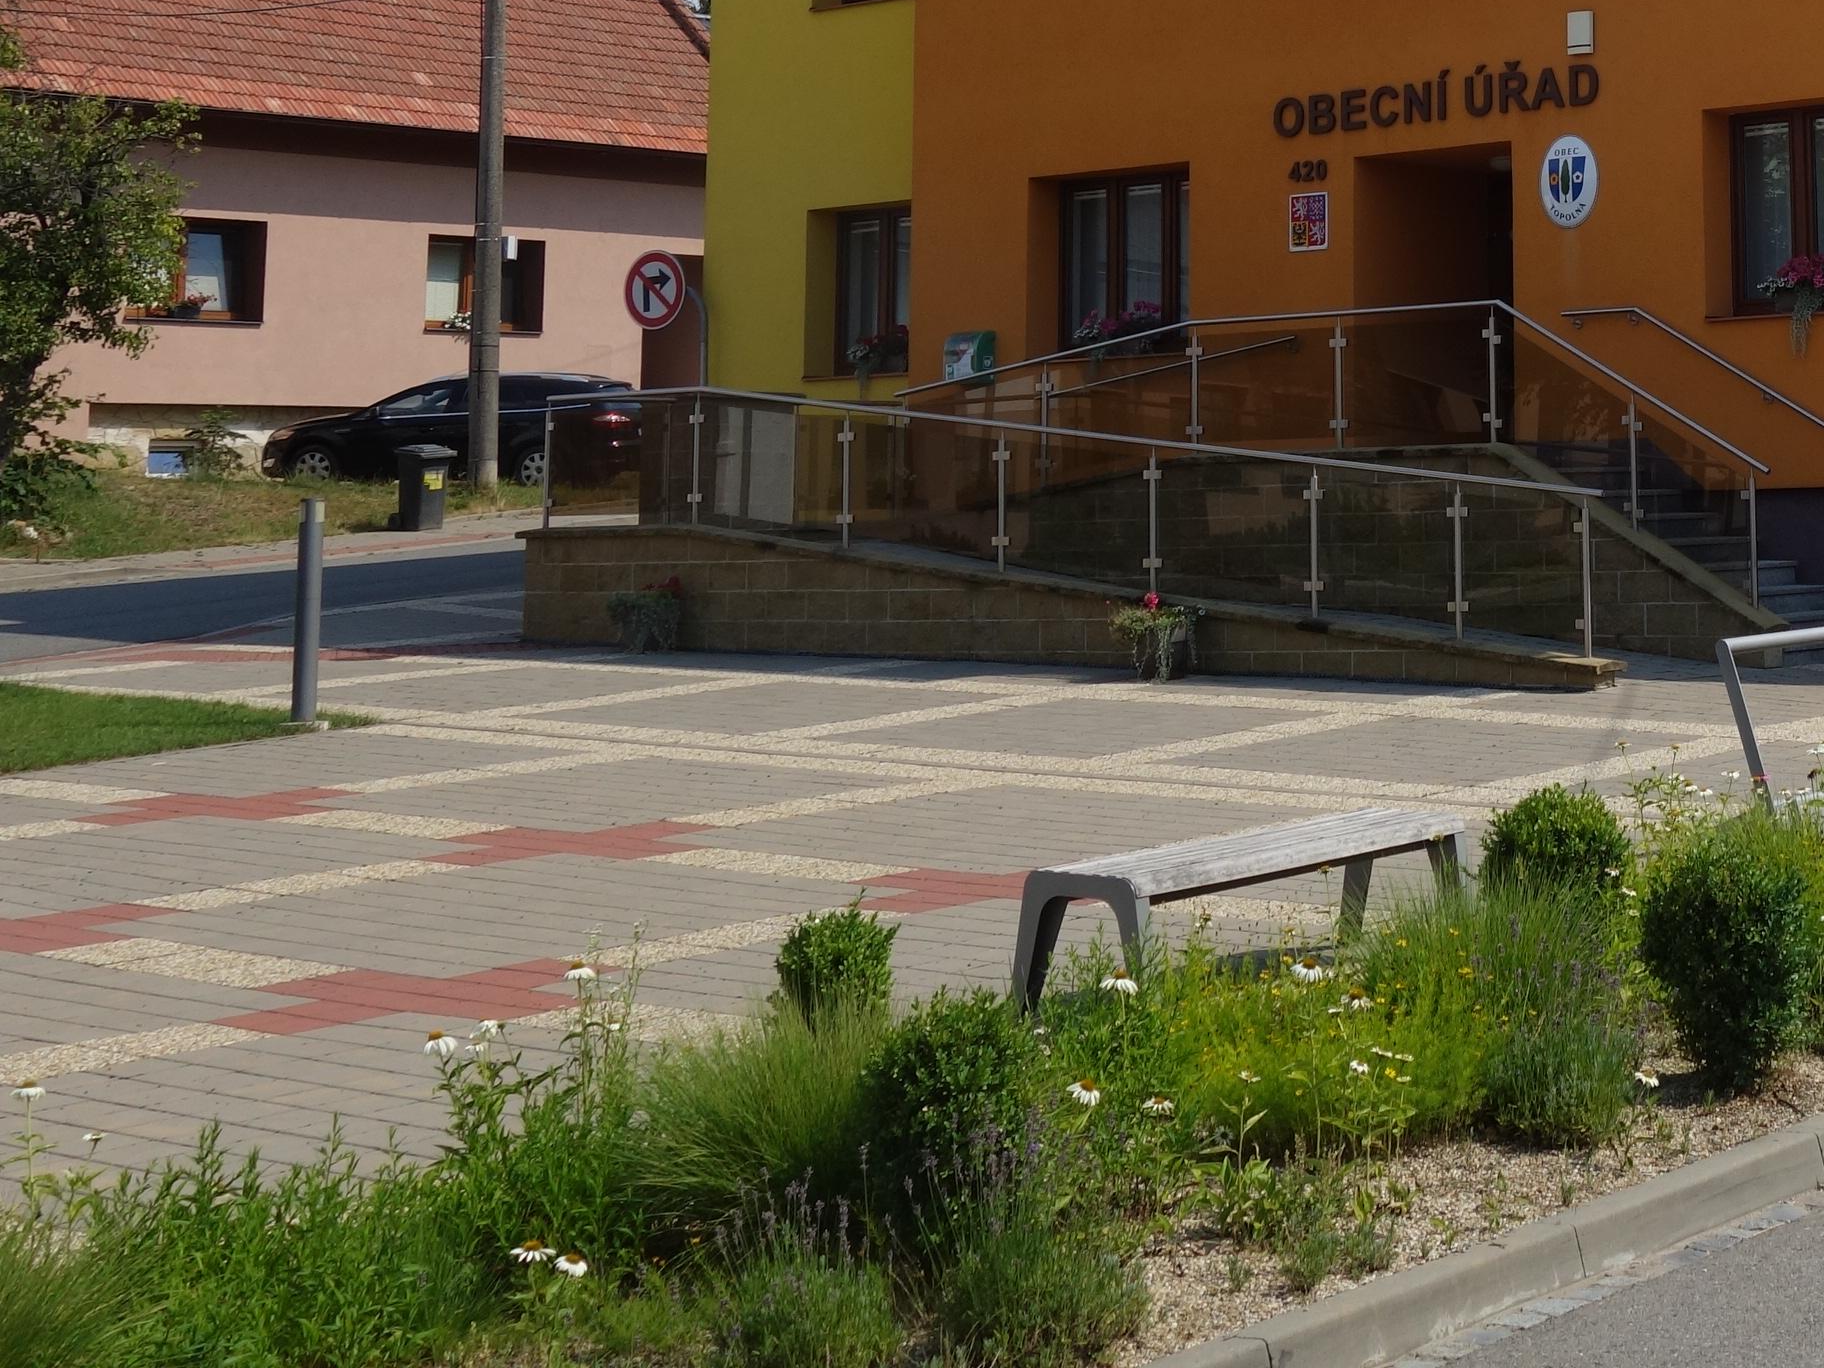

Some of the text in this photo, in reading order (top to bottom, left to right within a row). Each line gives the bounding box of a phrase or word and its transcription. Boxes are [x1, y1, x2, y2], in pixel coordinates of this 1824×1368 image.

[1273, 60, 1599, 138] OBECNÍ ÚŘAD
[1554, 147, 1580, 157] OBEC
[1288, 159, 1328, 183] 420
